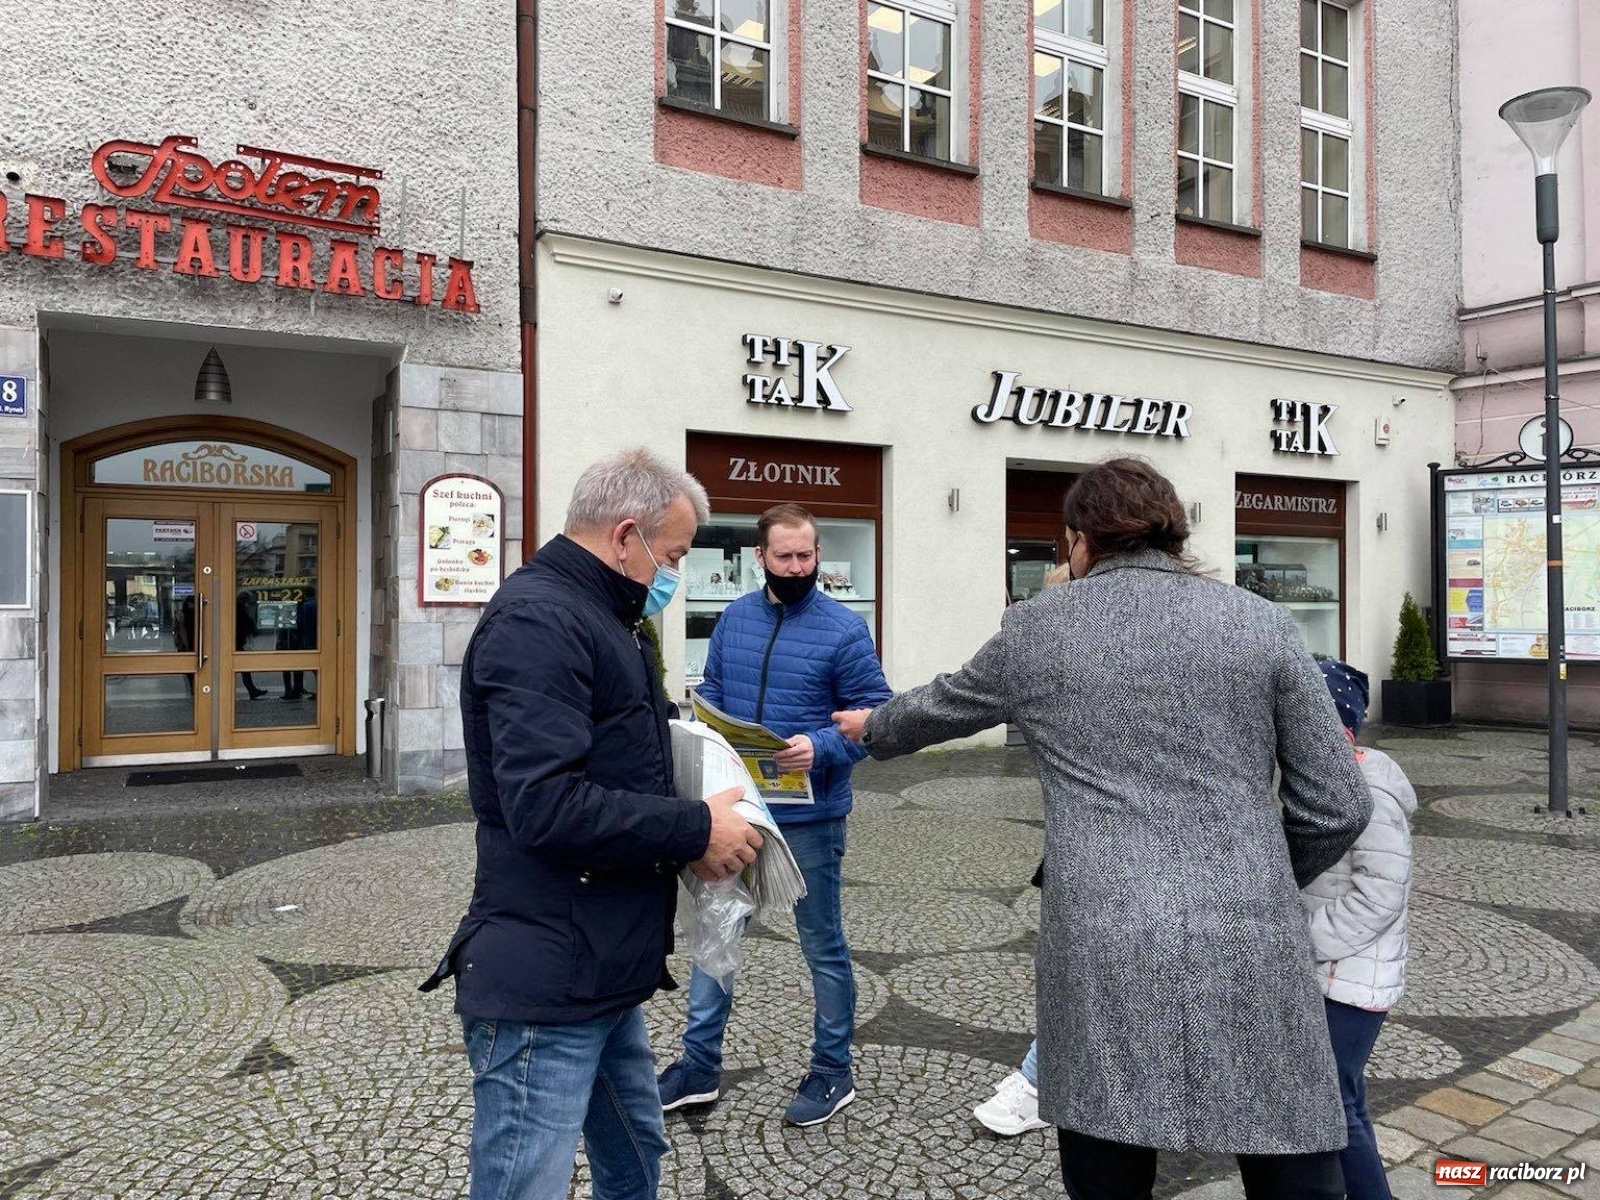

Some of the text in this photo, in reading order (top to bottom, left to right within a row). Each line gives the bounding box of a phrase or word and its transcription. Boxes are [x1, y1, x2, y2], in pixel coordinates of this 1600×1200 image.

[0, 191, 480, 313] ESTAURACJA
[2, 380, 18, 403] 8
[972, 370, 1194, 438] JUBILER
[727, 457, 841, 486] ZŁOTNIK
[432, 489, 492, 500] Szef kuchni
[1235, 491, 1337, 514] ZEGARMISTRZ
